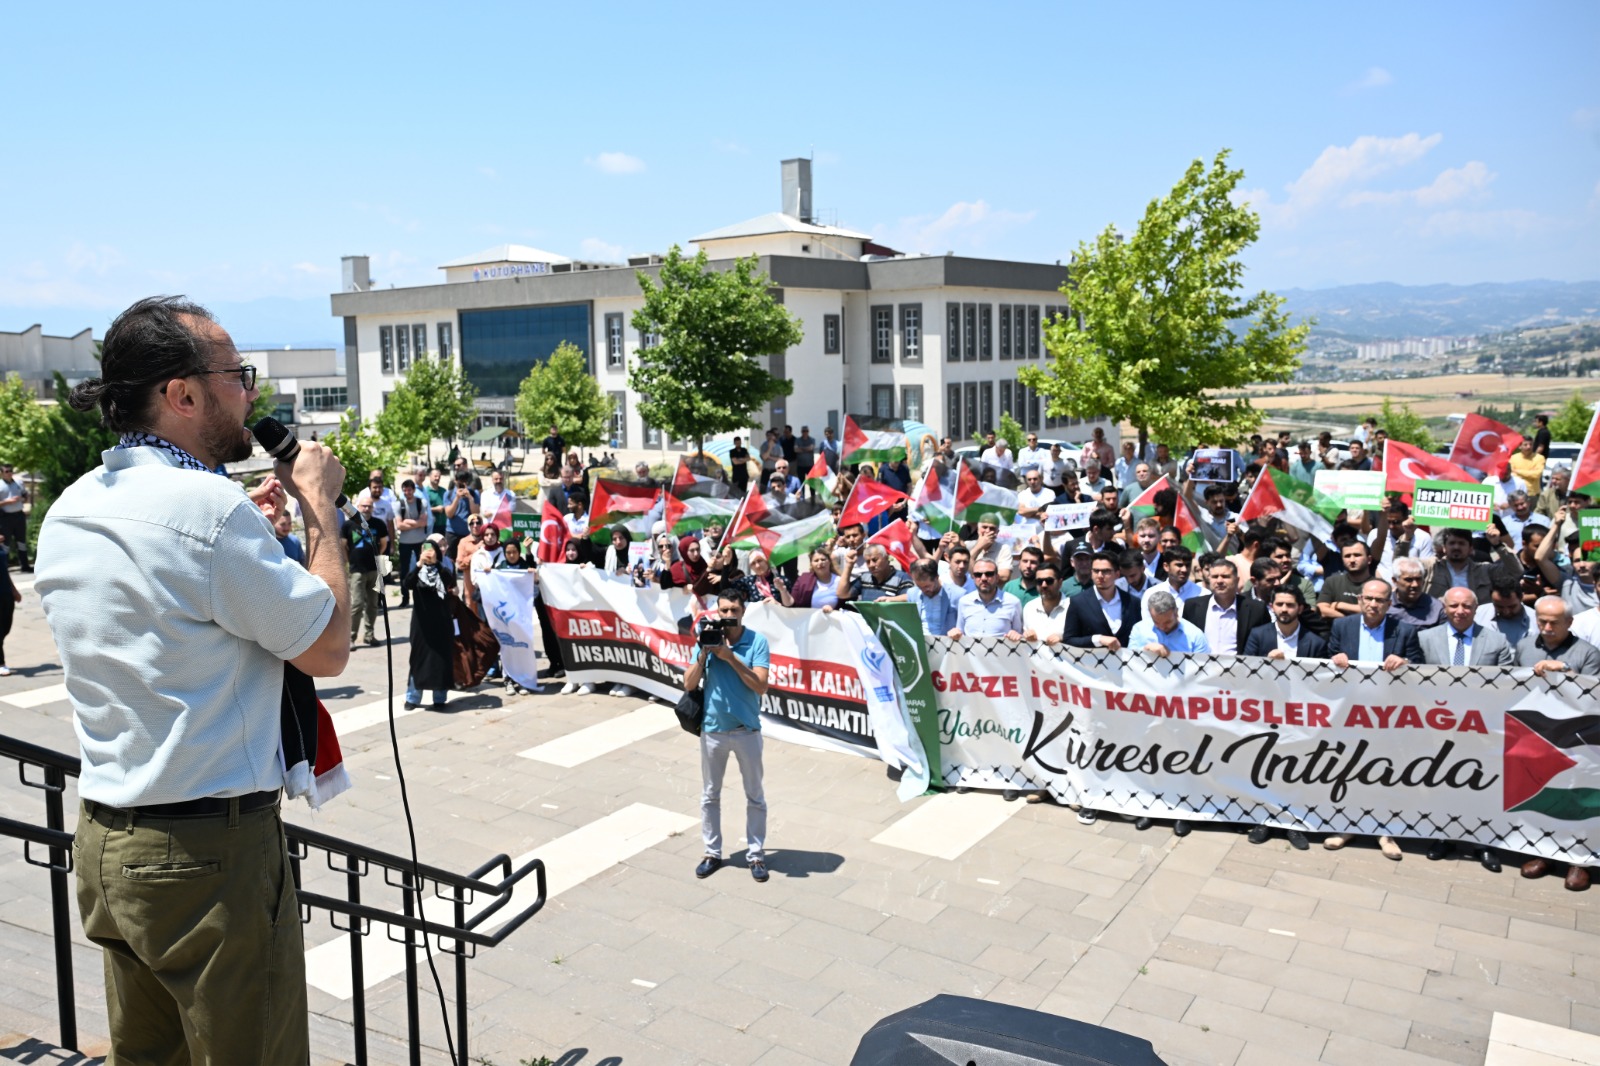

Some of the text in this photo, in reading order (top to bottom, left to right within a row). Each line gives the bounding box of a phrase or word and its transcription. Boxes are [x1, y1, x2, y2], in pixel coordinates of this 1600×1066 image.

[1451, 506, 1488, 521] DEVLET
[572, 643, 649, 670] İNSANLIK
[658, 639, 694, 664] VAH
[767, 663, 805, 689] SSİZ
[810, 670, 867, 700] KALM
[761, 693, 784, 716] AK
[930, 670, 1019, 698] GAZZE
[1030, 670, 1092, 709] İÇİN
[1104, 690, 1332, 728] KAMPÜSLER
[1344, 700, 1489, 735] AYAĞA
[1022, 710, 1213, 776] Küresel
[1221, 723, 1499, 803] İntifada
